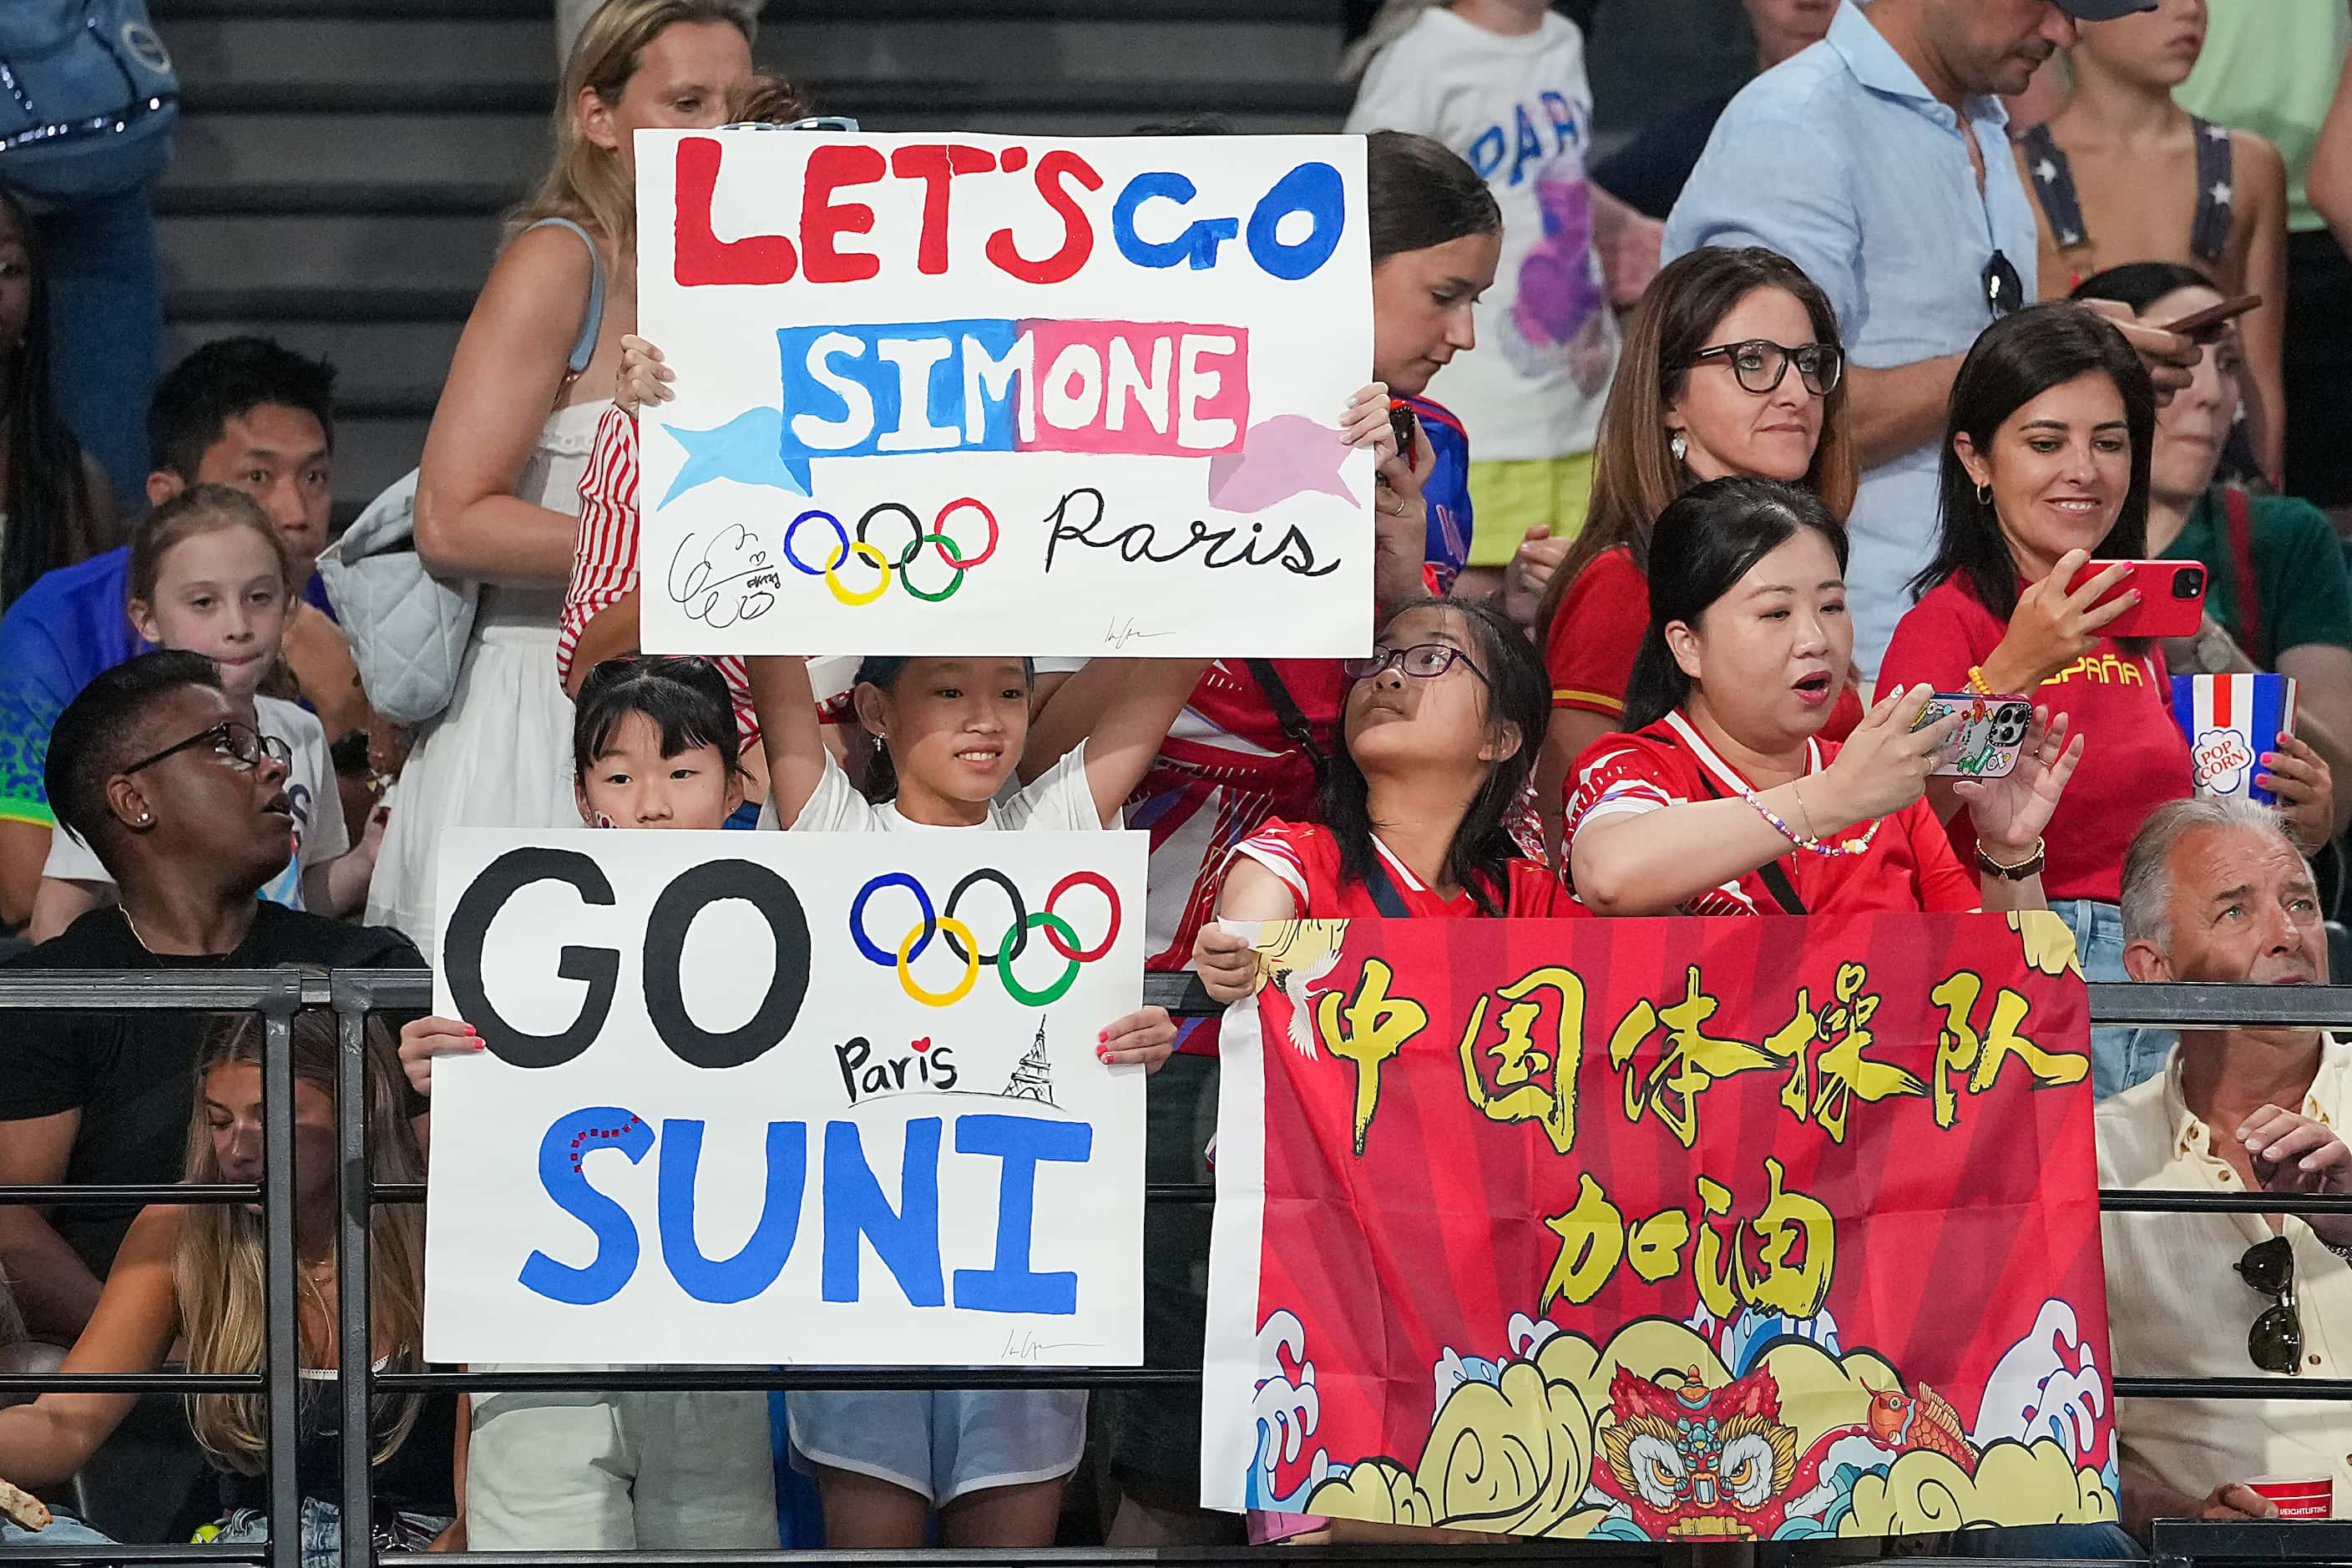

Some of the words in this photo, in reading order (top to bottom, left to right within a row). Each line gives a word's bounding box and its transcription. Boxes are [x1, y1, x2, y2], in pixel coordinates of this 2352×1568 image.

[674, 136, 1104, 286] LET'S
[1111, 161, 1345, 281] GO
[790, 330, 1237, 453] SIMONE
[1043, 488, 1342, 577] Paris
[2200, 749, 2245, 780] CORN
[2201, 741, 2232, 765] POP
[443, 847, 812, 1070] GO
[834, 1036, 958, 1103] Paris
[1317, 958, 2090, 1156] 中国体操队
[518, 1106, 1093, 1315] SUNI
[1540, 1157, 1836, 1319] 加油
